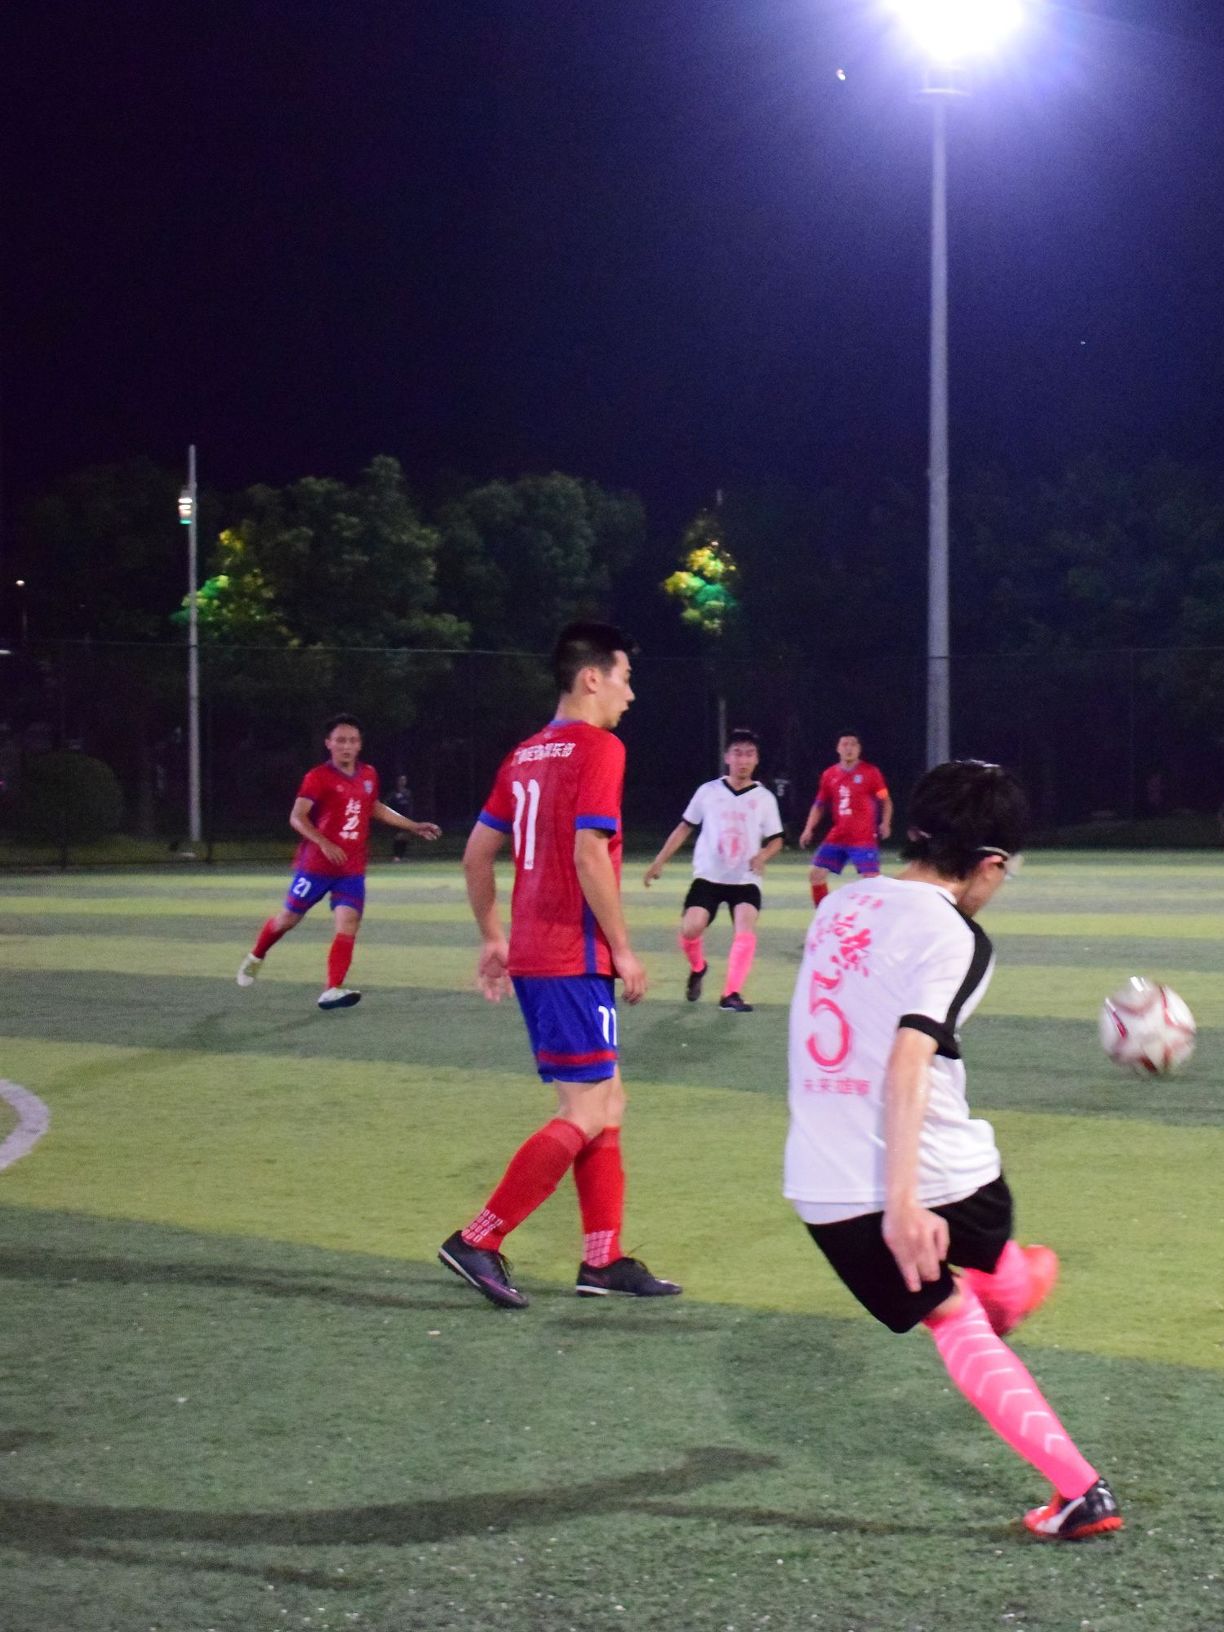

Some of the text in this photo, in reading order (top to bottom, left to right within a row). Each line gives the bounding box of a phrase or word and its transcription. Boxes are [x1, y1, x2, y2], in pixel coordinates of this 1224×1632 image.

[512, 779, 540, 870] 11
[292, 877, 312, 897] 21
[598, 1005, 617, 1047] 11
[806, 970, 852, 1073] 5
